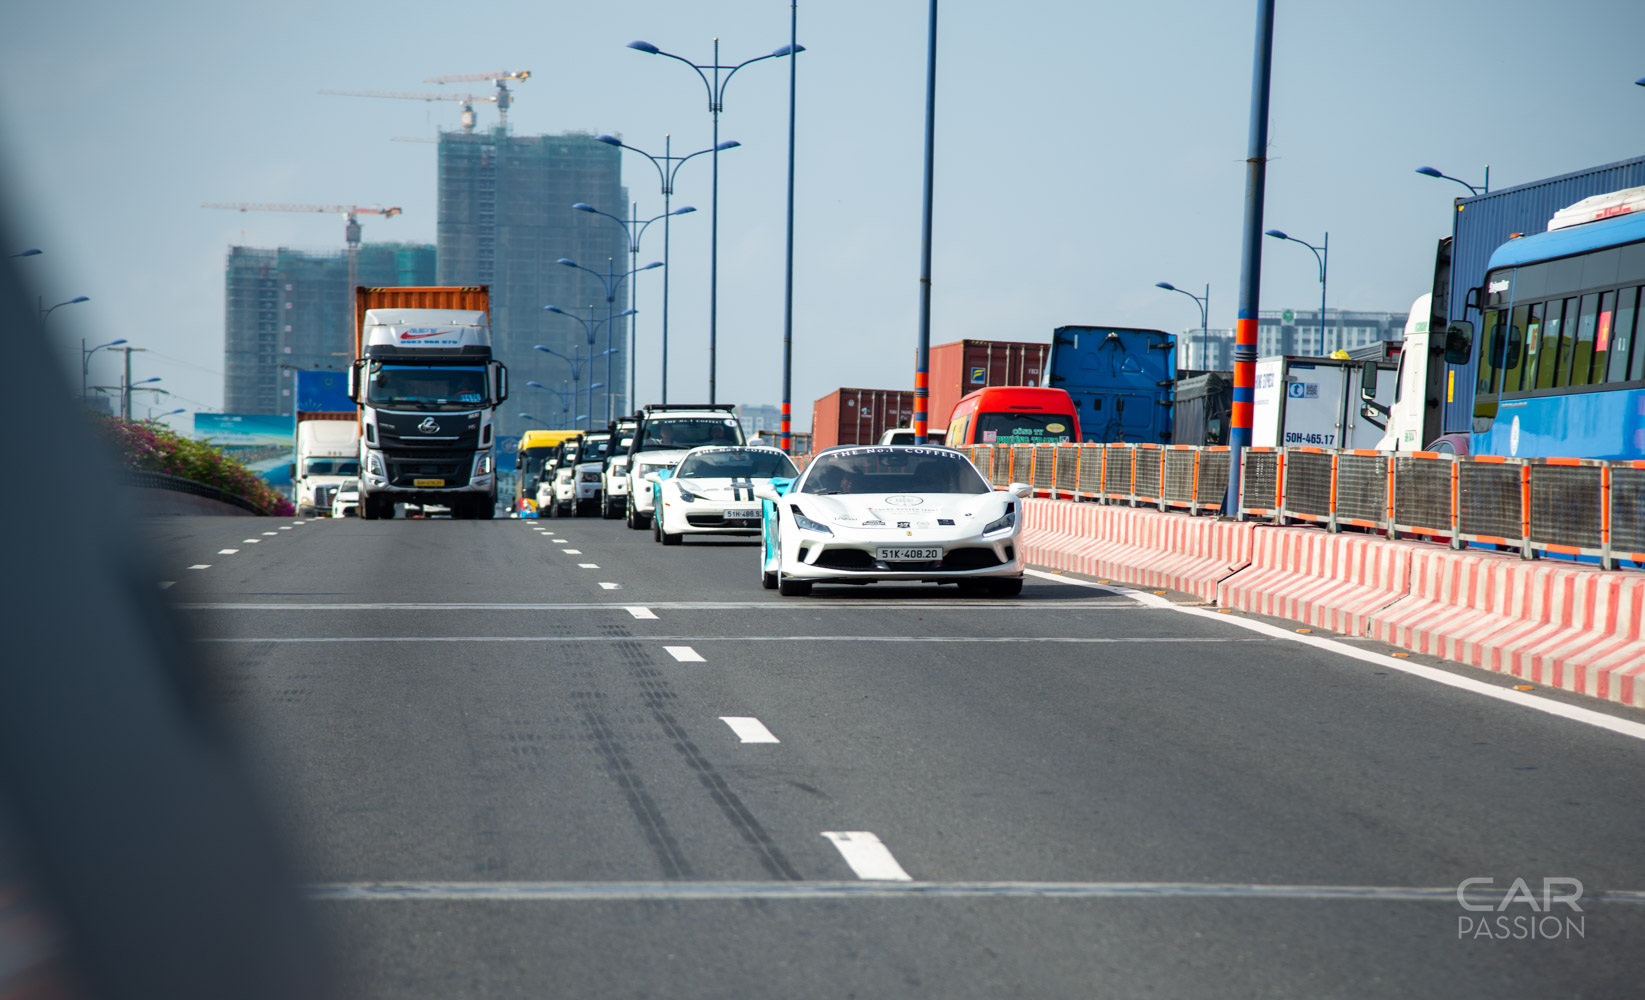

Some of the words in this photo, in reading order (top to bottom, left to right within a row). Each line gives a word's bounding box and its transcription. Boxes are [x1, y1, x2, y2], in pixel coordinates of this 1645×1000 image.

[1285, 432, 1335, 445] 50H-465.17
[831, 449, 859, 459] THE
[904, 448, 961, 460] COFFEE!
[882, 549, 938, 559] 51K-408.20
